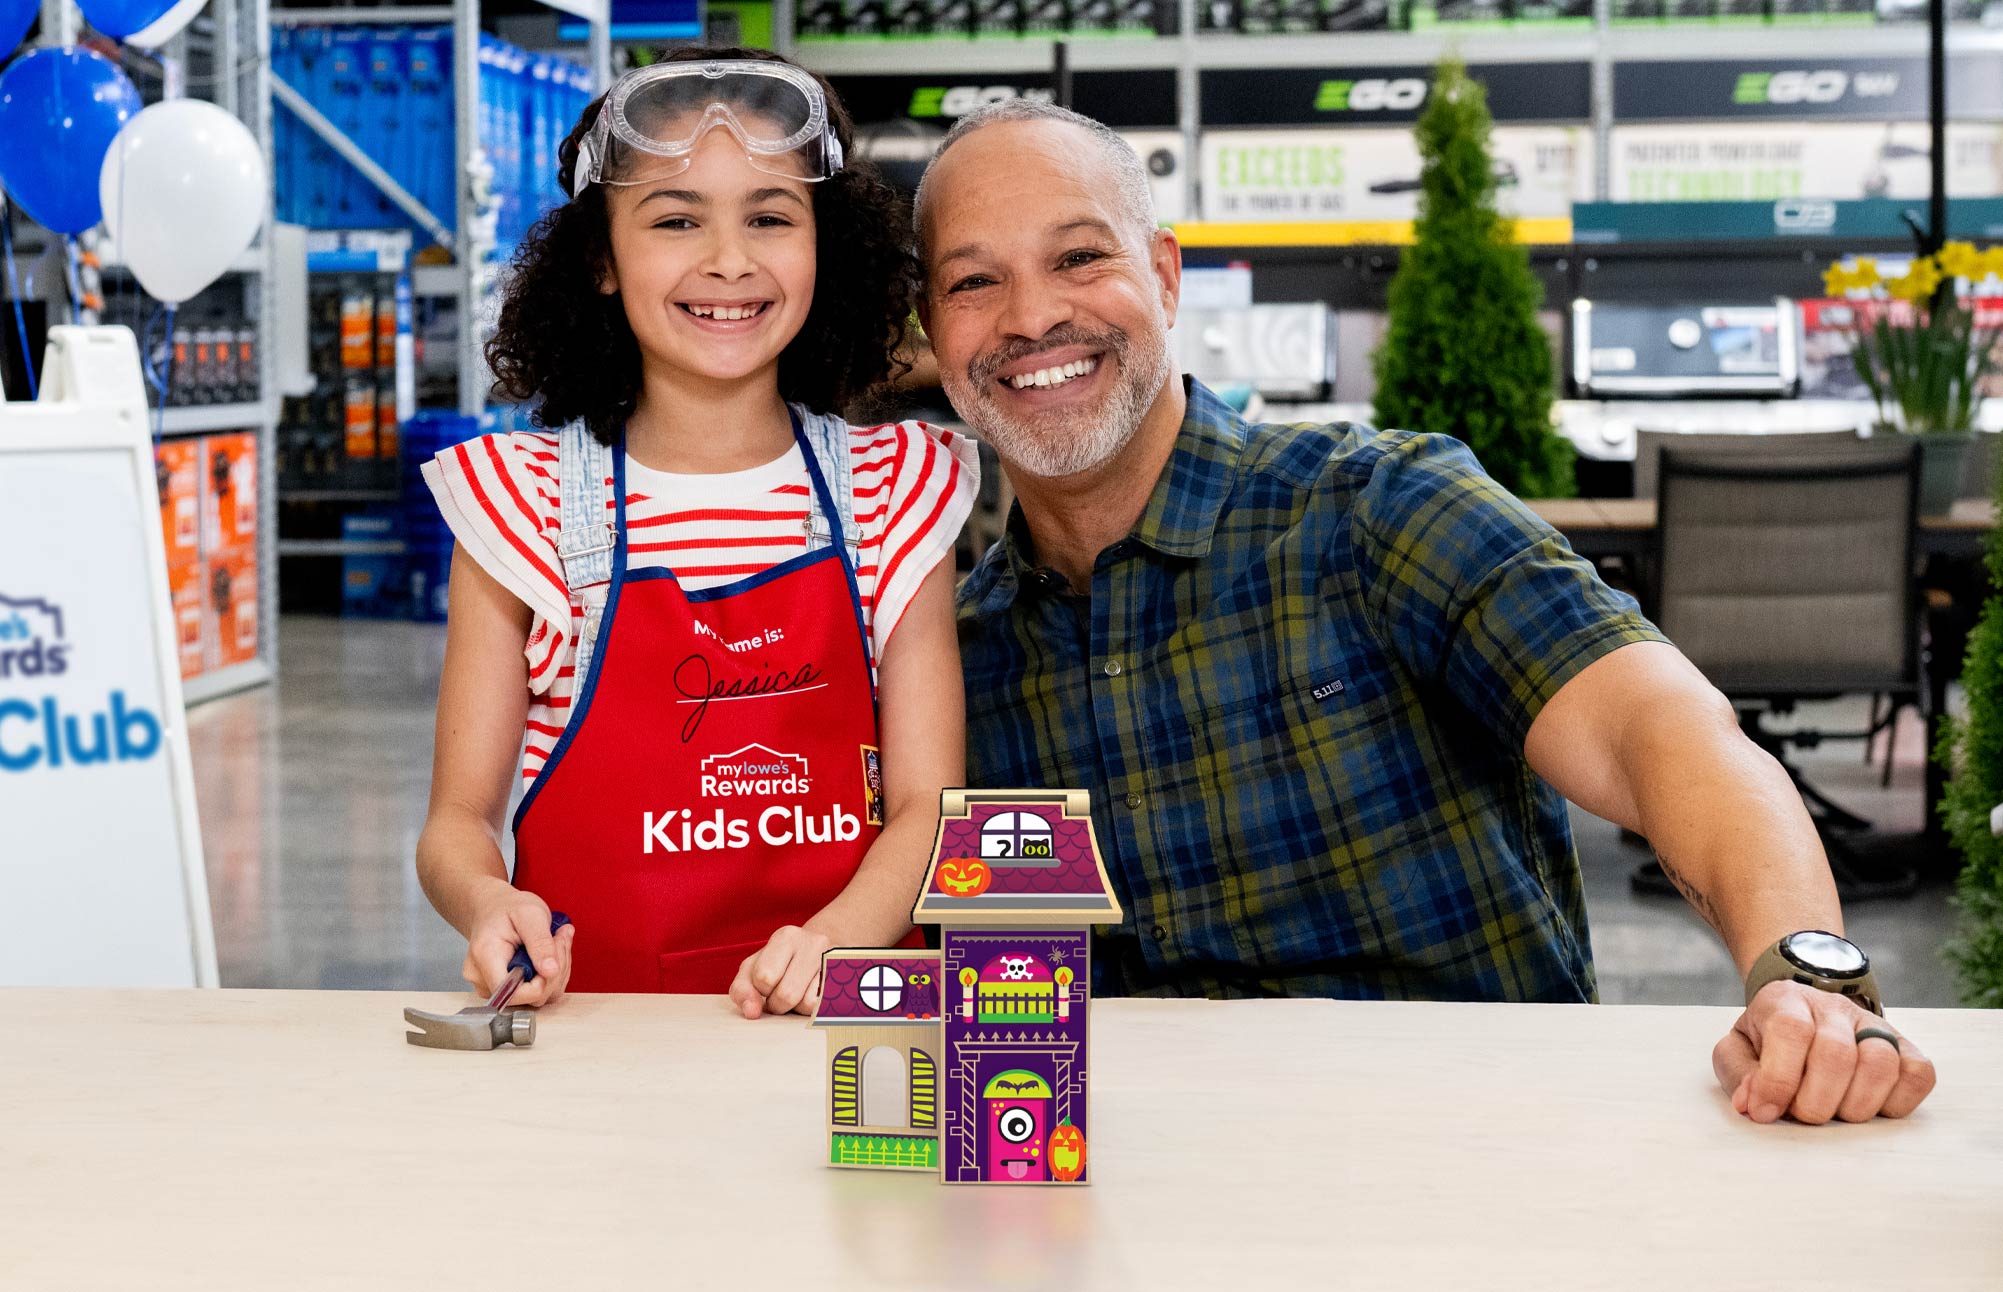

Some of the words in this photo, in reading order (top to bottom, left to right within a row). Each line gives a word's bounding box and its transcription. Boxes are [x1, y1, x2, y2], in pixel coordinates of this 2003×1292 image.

[1315, 79, 1427, 111] EGO
[1733, 71, 1848, 103] EGO
[1218, 147, 1344, 187] EXCEEDS
[719, 636, 762, 653] me
[764, 628, 784, 644] is:
[674, 653, 822, 743] Jessica
[1313, 684, 1334, 699] 5.11
[0, 690, 161, 772] Club
[701, 773, 810, 797] Rewards
[643, 808, 750, 854] Kids
[758, 803, 861, 846] Club
